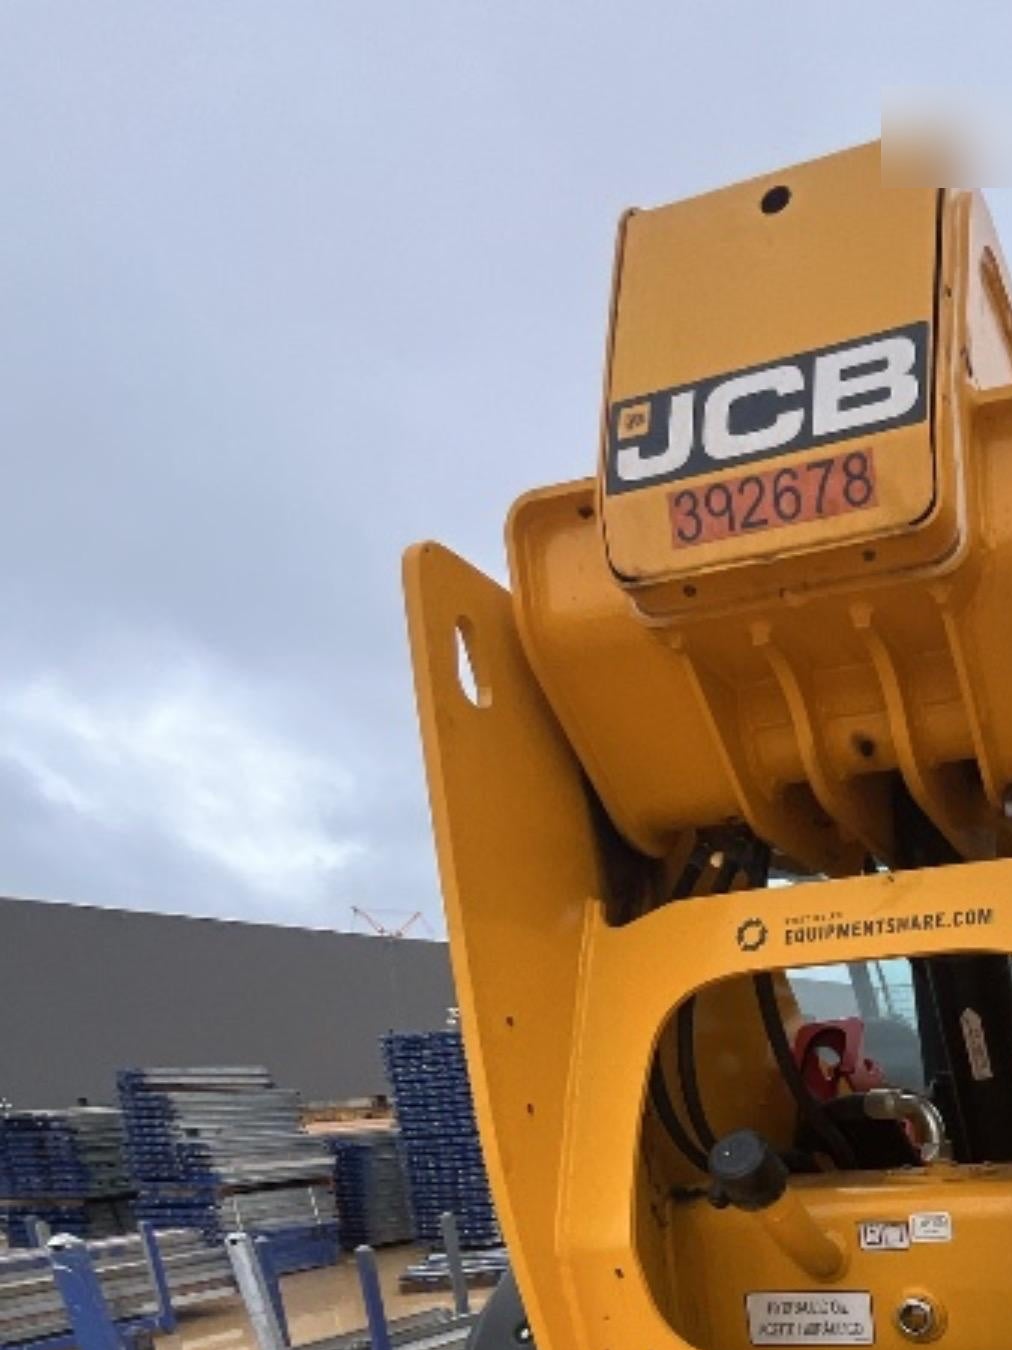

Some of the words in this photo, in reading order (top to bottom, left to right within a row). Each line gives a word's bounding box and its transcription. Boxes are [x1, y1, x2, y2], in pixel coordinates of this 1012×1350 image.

[615, 336, 918, 481] JCB
[672, 451, 874, 544] 392678
[784, 908, 993, 946] EQUIPMENTSHARE.COM
